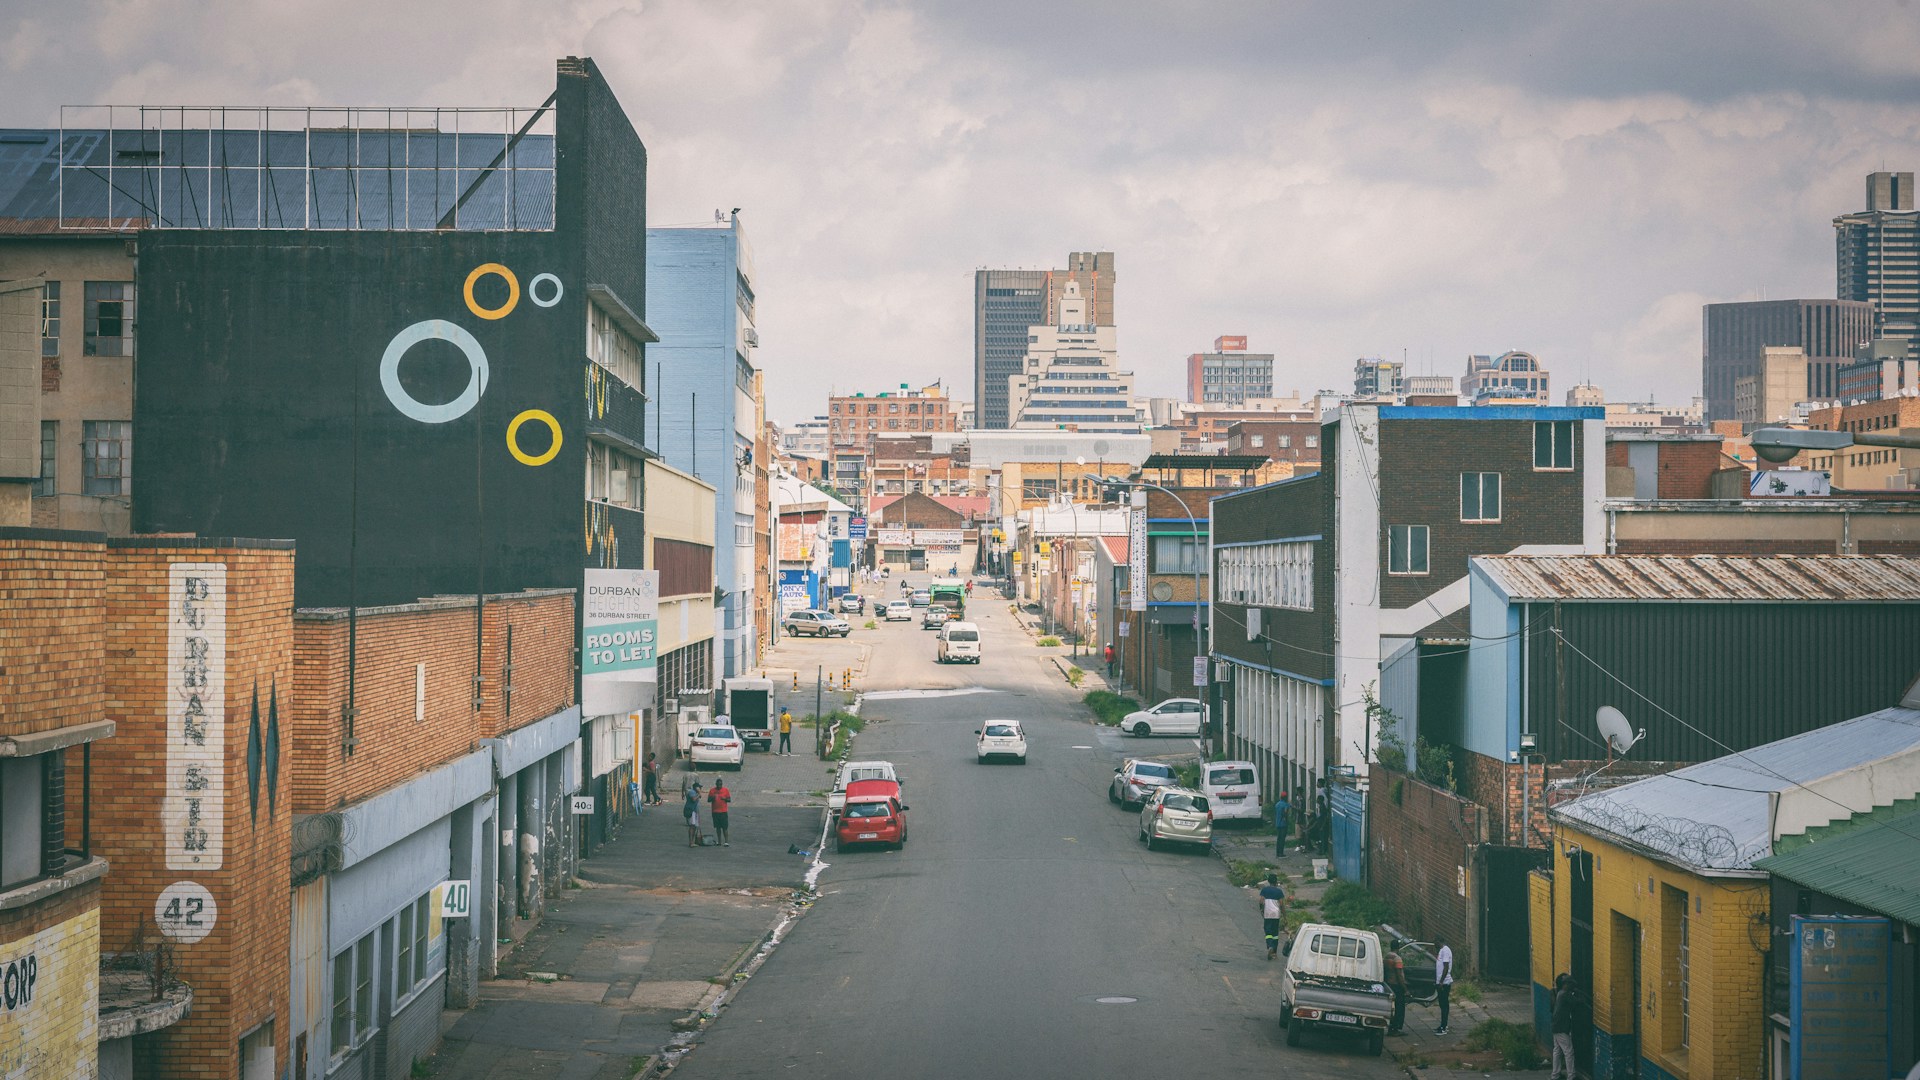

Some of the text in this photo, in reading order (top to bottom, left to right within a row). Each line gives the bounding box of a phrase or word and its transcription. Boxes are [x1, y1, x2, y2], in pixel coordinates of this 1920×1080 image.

[589, 586, 641, 596] DURBAN
[589, 596, 640, 612] HEIGHTS
[586, 629, 654, 649] ROOMS
[183, 576, 210, 747] DURBAN
[590, 646, 654, 666] TO LET
[444, 884, 468, 913] 40
[163, 897, 204, 927] 42
[0, 955, 37, 1010] ORP
